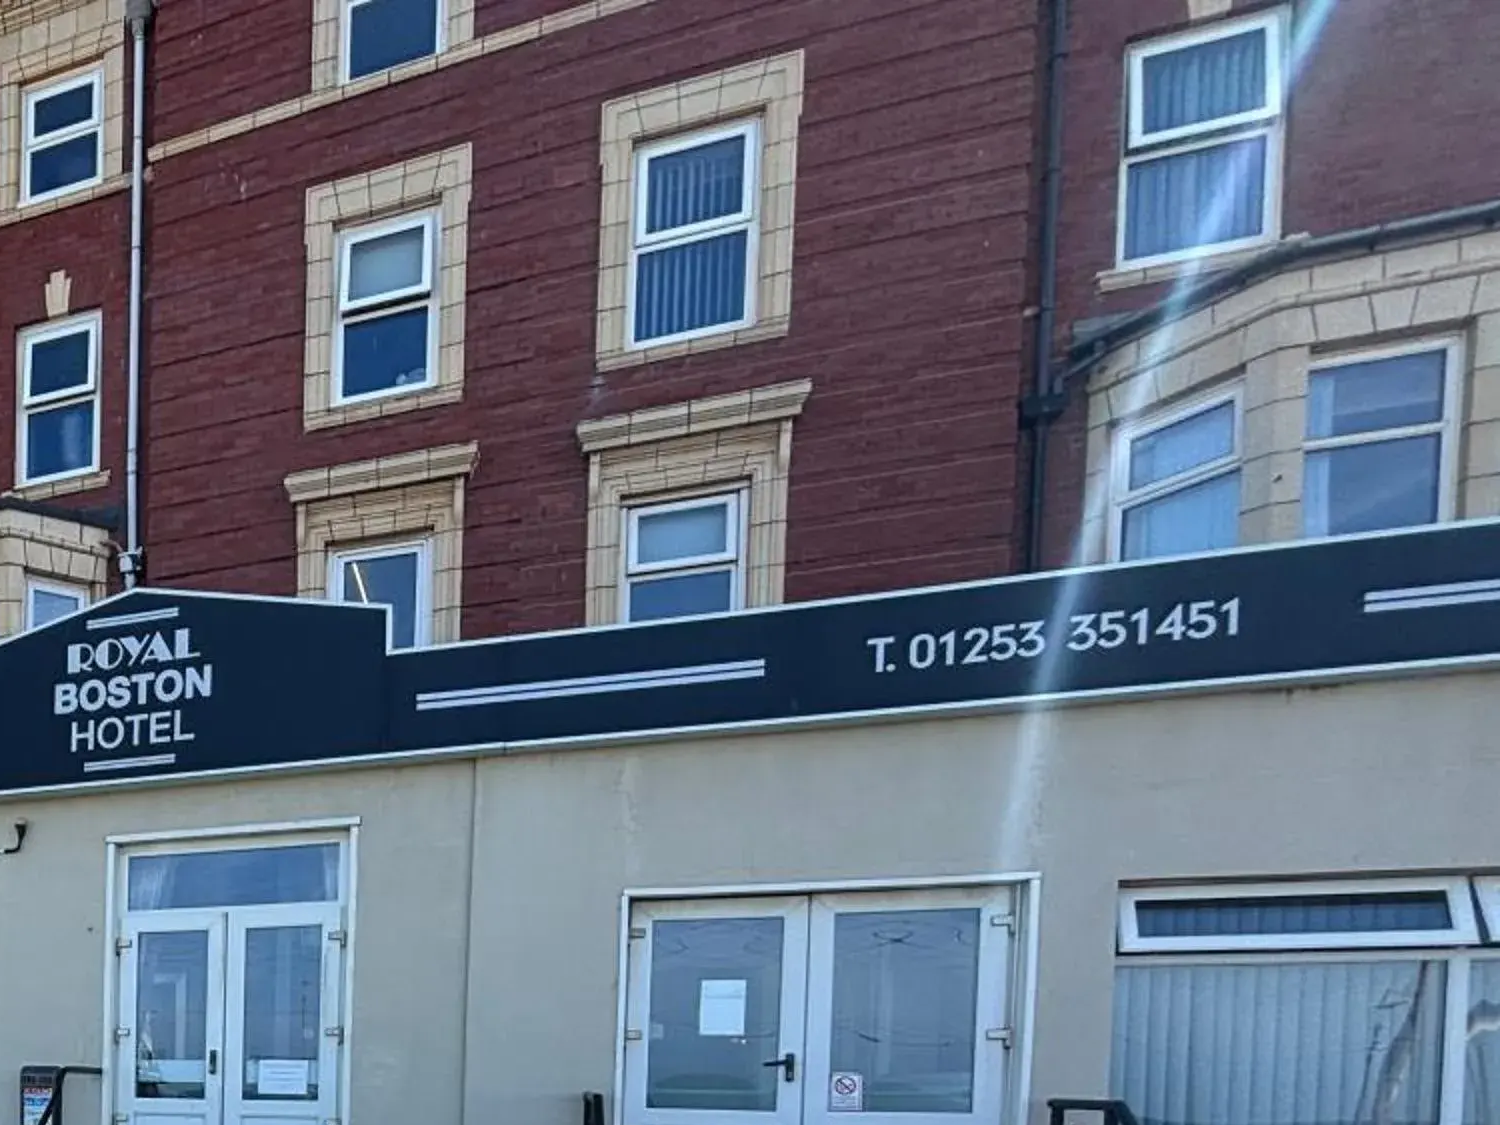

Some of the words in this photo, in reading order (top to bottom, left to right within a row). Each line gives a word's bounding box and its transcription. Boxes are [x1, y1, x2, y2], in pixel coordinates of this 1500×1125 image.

[67, 628, 201, 674] ROYAL
[908, 620, 1046, 670] 01253
[1065, 597, 1241, 652] 351451
[53, 664, 213, 715] BOSTON
[70, 710, 195, 752] HOTEL
